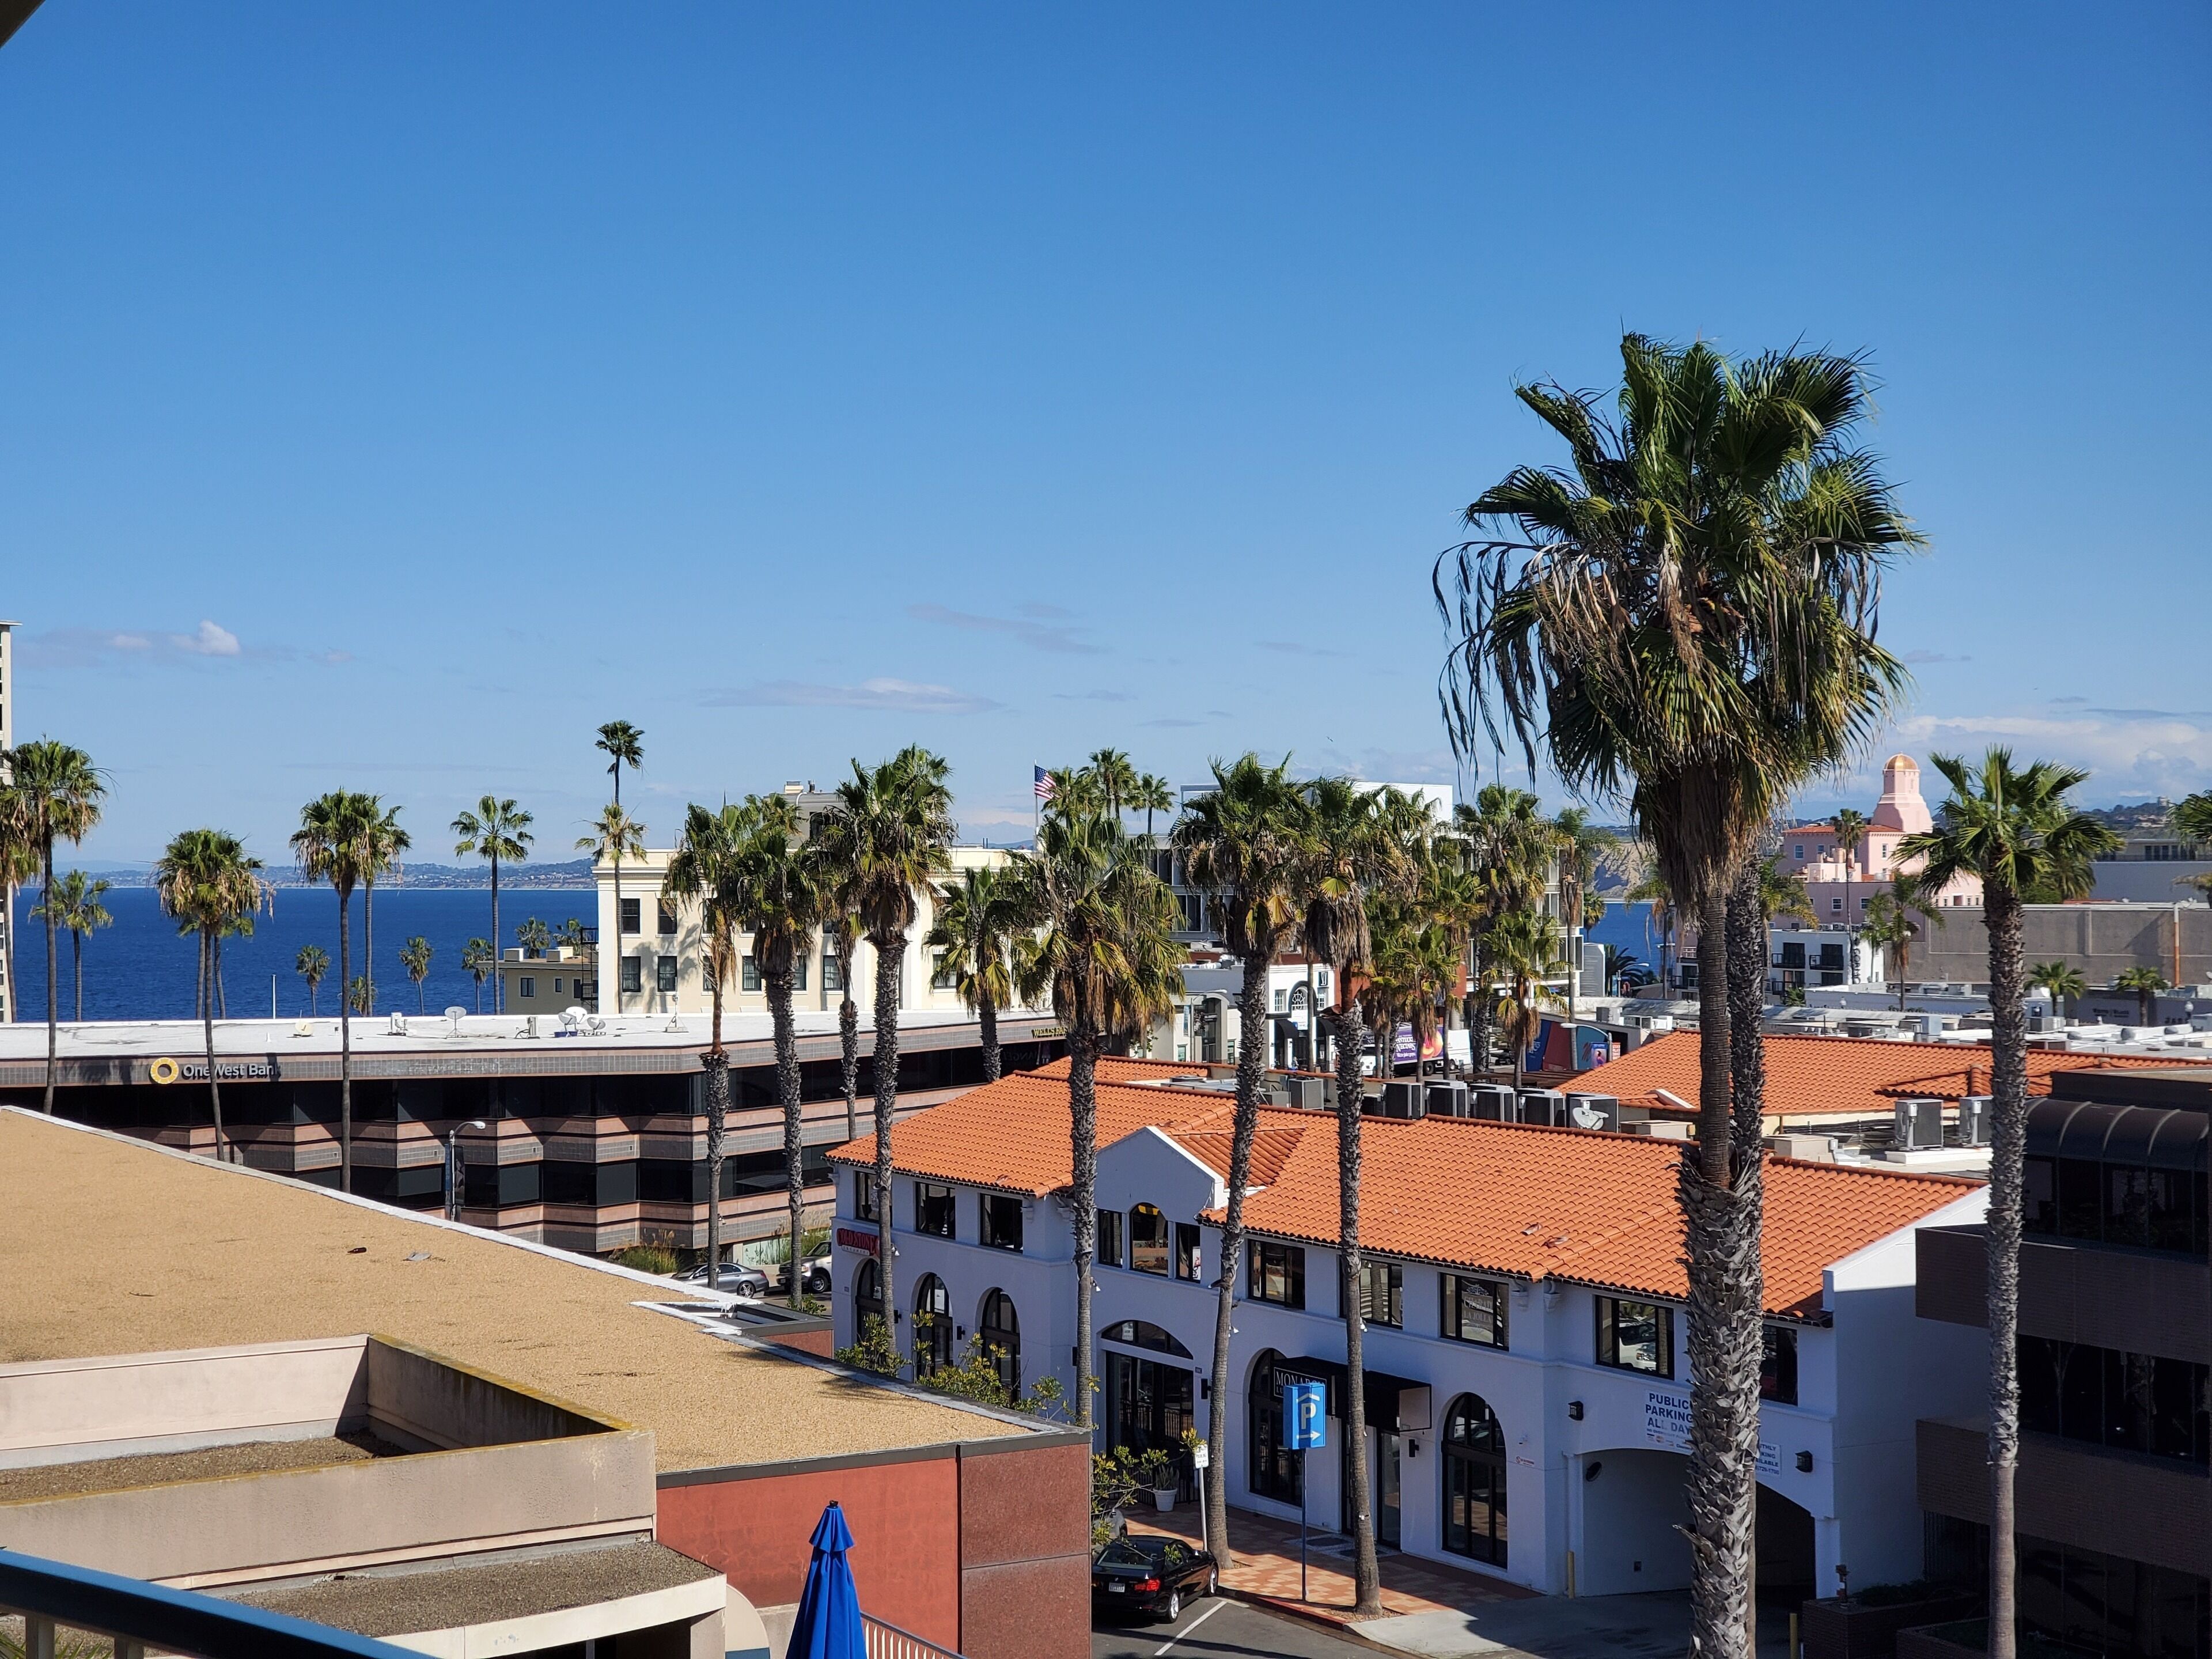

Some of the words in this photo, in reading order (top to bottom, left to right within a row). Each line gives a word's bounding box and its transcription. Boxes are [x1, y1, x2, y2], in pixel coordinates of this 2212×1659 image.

[1034, 1028, 1055, 1036] WELLS
[1649, 1393, 1689, 1410] PUBLIC
[1301, 1403, 1316, 1430] P
[1645, 1404, 1694, 1423] PARKING
[1671, 1422, 1691, 1435] DAY
